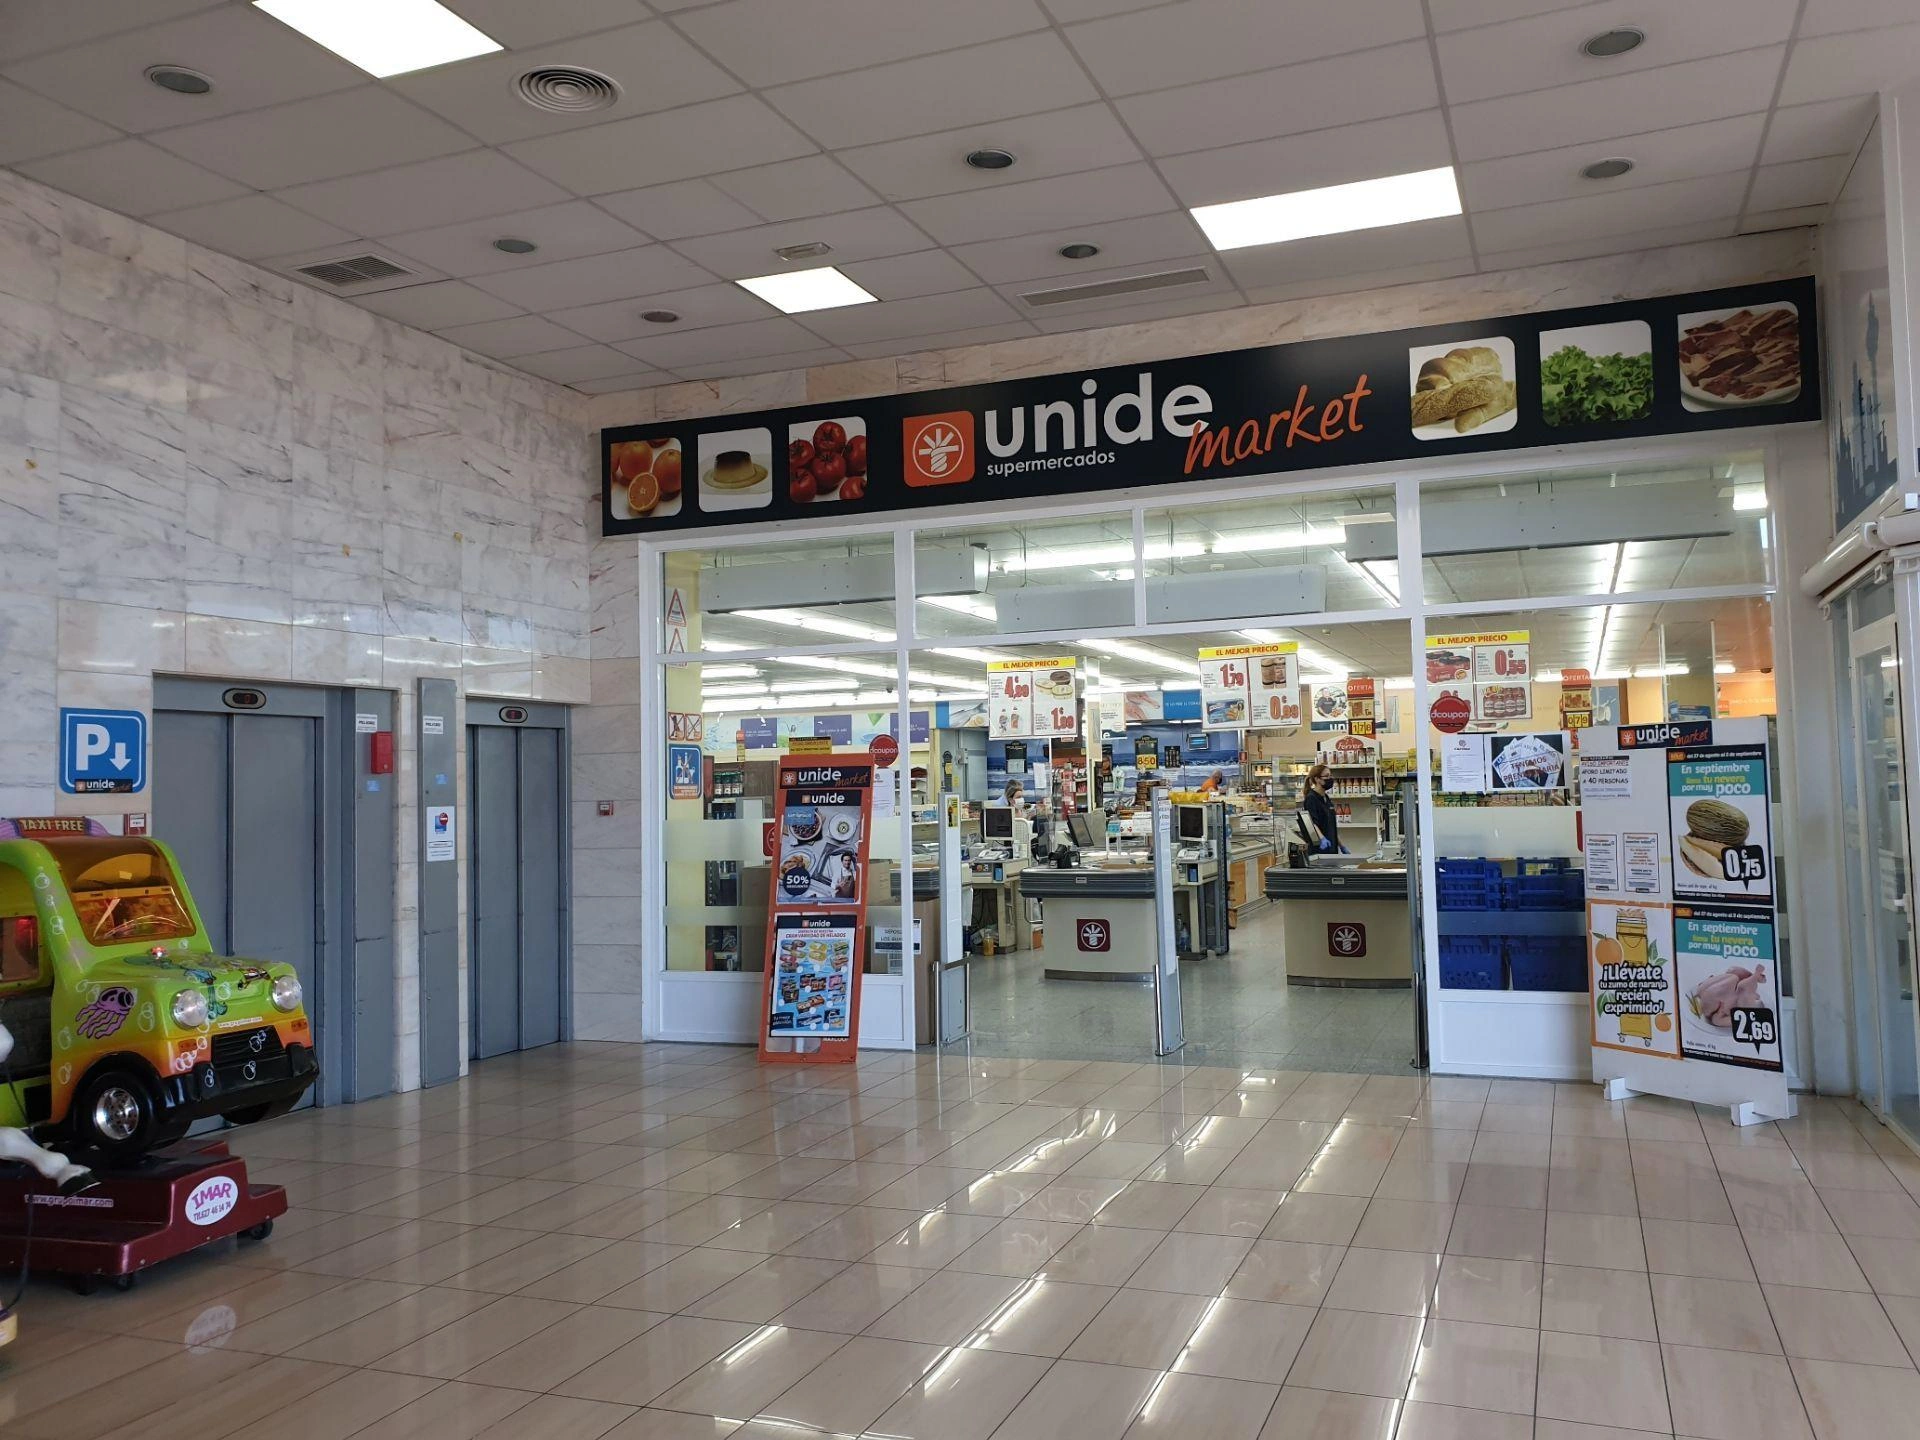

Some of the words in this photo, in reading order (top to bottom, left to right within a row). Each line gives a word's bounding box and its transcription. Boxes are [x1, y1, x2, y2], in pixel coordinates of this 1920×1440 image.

[984, 372, 1213, 458] unide
[1183, 374, 1373, 475] market
[986, 450, 1116, 478] supermercados
[1437, 637, 1446, 645] EL
[1448, 635, 1476, 644] MEJOR
[1478, 634, 1508, 642] PRECIO
[1224, 647, 1250, 655] MEJOR
[1252, 645, 1279, 653] PRECIO
[1011, 661, 1034, 669] MEJOR
[1035, 660, 1059, 668] PRECIO
[1636, 724, 1681, 742] unide
[1674, 728, 1709, 747] market
[76, 723, 111, 771] P
[798, 767, 842, 782] unide
[1681, 765, 1692, 774] En
[1695, 763, 1750, 775] septiembre
[86, 779, 116, 789] unide
[1682, 784, 1694, 793] por
[1696, 783, 1713, 793] muy
[1715, 782, 1751, 798] poco
[811, 792, 846, 804] unide
[55, 819, 85, 832] FREE
[786, 875, 810, 885] 50%
[1688, 922, 1699, 931] En
[1702, 923, 1759, 936] septiembre
[1688, 941, 1702, 950] por
[1702, 942, 1720, 952] muy
[1723, 944, 1759, 959] poco
[1603, 962, 1662, 982] ¡Llévate
[1600, 980, 1608, 989] tu
[1629, 980, 1638, 988] de
[1639, 980, 1667, 990] naranja
[1616, 988, 1650, 1001] recién
[1604, 1001, 1664, 1017] exprimido!
[192, 1182, 232, 1210] IMAR
